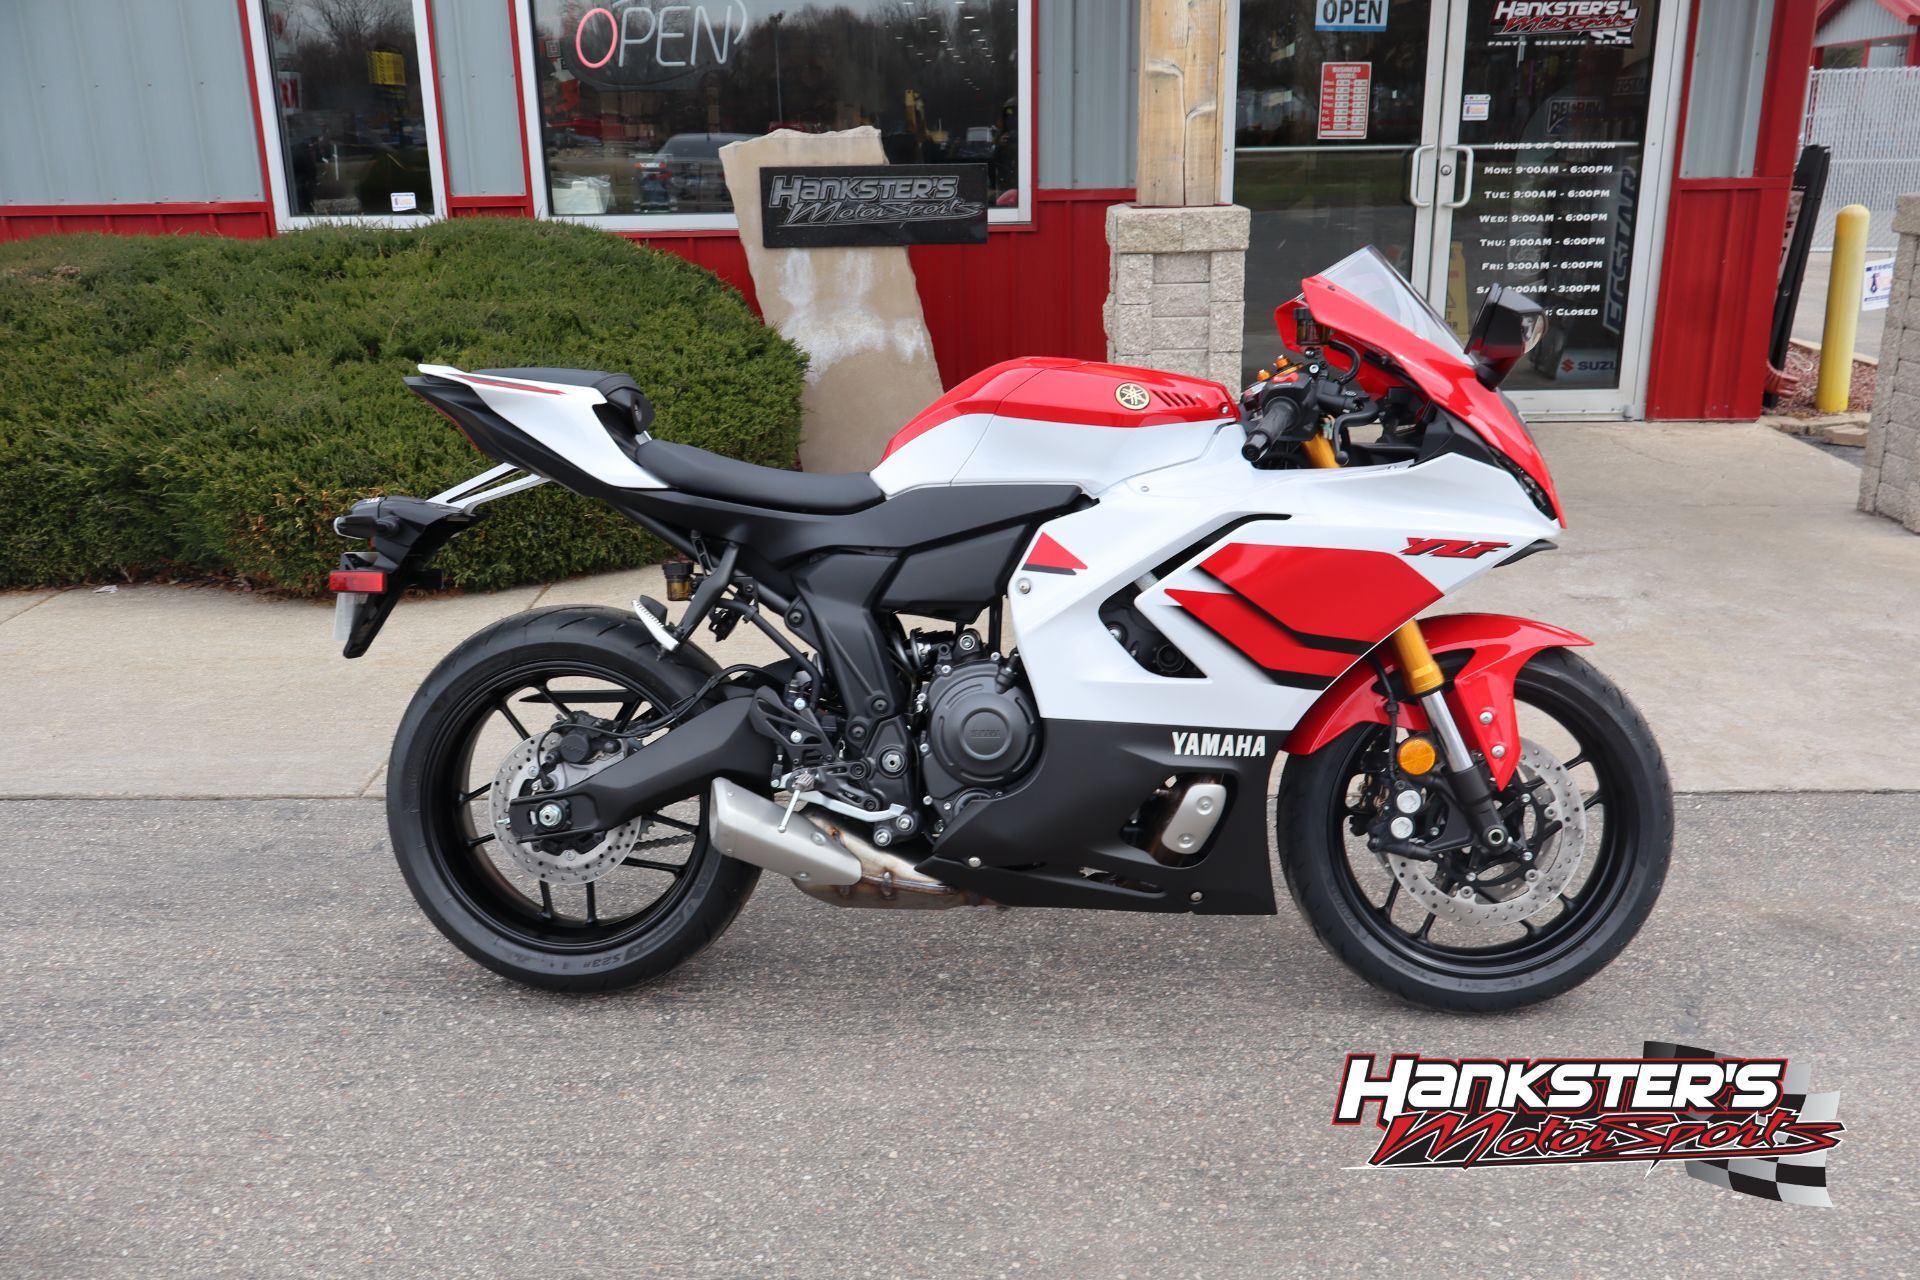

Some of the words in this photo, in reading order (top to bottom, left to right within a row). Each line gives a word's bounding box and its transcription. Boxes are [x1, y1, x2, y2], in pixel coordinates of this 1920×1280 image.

[1322, 0, 1383, 25] OPEN
[575, 6, 733, 69] OPEN
[1552, 141, 1616, 150] OPERATION
[1484, 166, 1512, 174] MON:
[1570, 165, 1613, 174] 6:00PM
[1484, 190, 1510, 199] TUE:
[1513, 190, 1557, 198] 9:00AM
[1567, 189, 1610, 198] 6:00PM
[784, 197, 986, 226] MotorSports
[1479, 214, 1508, 223] WED:
[1511, 214, 1554, 222] 9:00AM
[1565, 213, 1608, 222] 6:00PM
[1479, 238, 1506, 247] THU:
[1509, 238, 1552, 247] 9:00AM
[1562, 237, 1606, 246] 6:00PM
[1481, 262, 1504, 270] FRI:
[1507, 261, 1550, 270] 9:00AM
[1560, 260, 1603, 269] 6:00PM
[1558, 284, 1600, 293] 3:00PM
[1556, 308, 1599, 316] CLOSED
[1399, 537, 1512, 559] YZF
[1171, 731, 1267, 757] YAMAHA
